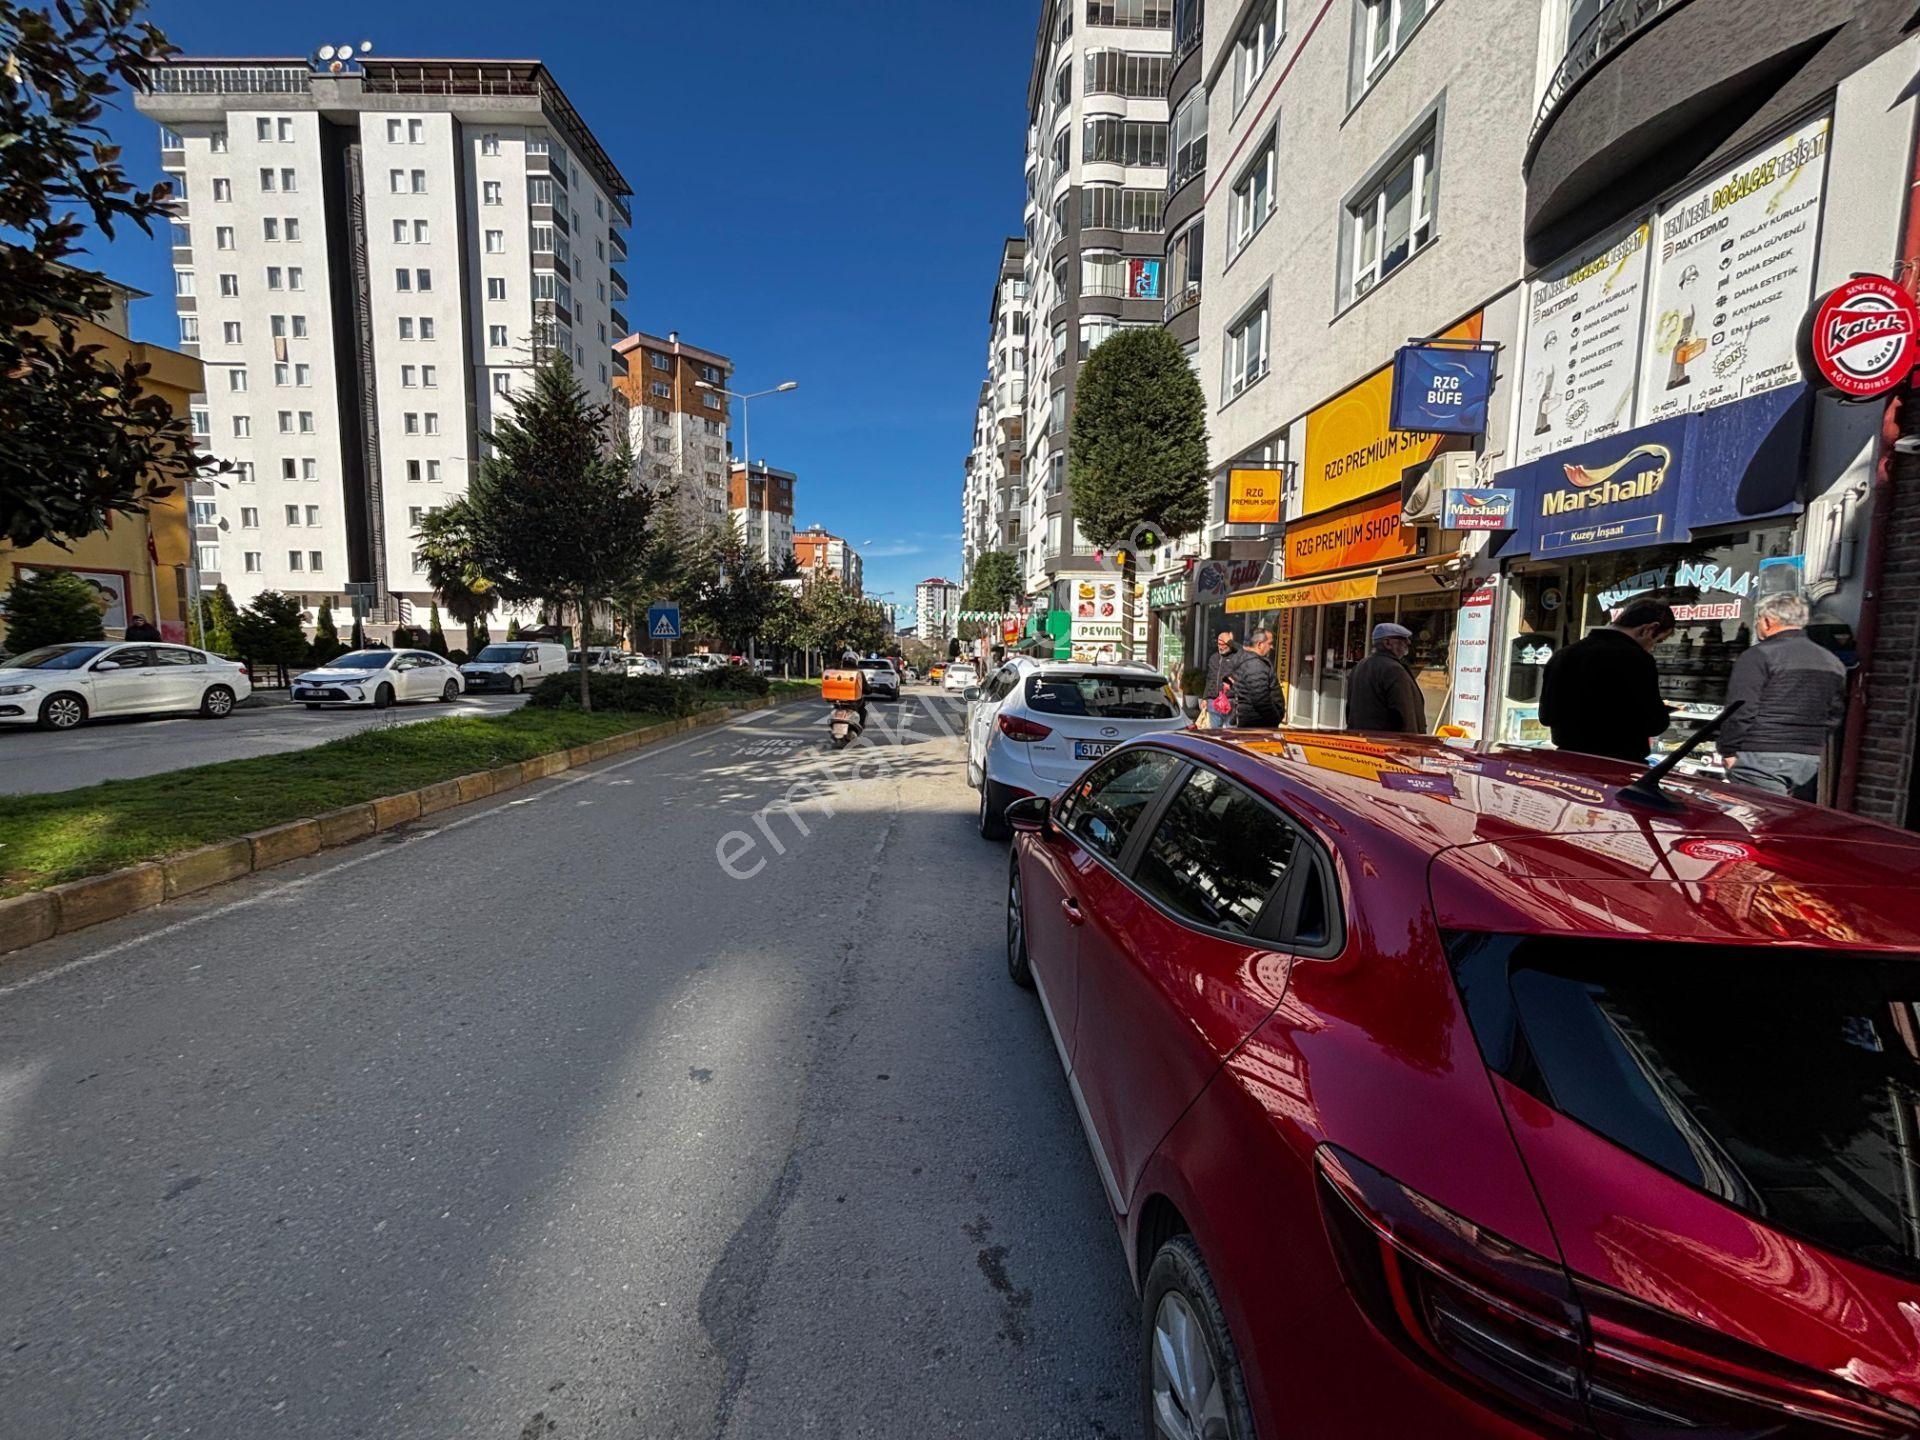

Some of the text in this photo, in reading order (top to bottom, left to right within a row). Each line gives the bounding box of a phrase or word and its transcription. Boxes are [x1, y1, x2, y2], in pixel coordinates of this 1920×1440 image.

[1712, 157, 1777, 215] DOĞALGAZ
[1740, 196, 1818, 241] KOLAY KURULUM
[1675, 217, 1729, 253] PAKTERMO
[1735, 248, 1793, 279] DAHA ESNEK
[1737, 244, 1762, 261] DAHA
[1734, 266, 1798, 299] DAHA ESTETİK
[1846, 283, 1875, 296] SINCE
[1732, 291, 1783, 318] KAYNAKSIZ
[1755, 361, 1793, 380] MONTAJ
[1830, 370, 1890, 390] AĞIZ TADINIZ
[1433, 376, 1459, 389] RZG
[1427, 388, 1463, 405] BÜFE
[1324, 459, 1344, 481] RZG
[1345, 434, 1397, 474] PREMİUM
[1245, 488, 1264, 498] RZG
[1260, 498, 1276, 506] SHOP
[1542, 470, 1655, 517] Marshall
[1451, 504, 1506, 515] Marshall
[1296, 514, 1400, 558] RZG PREMİUM SHOP
[1571, 530, 1595, 541] Kuzey
[1597, 566, 1672, 612] KUZEY
[1669, 599, 1741, 621] ZEMELERİ
